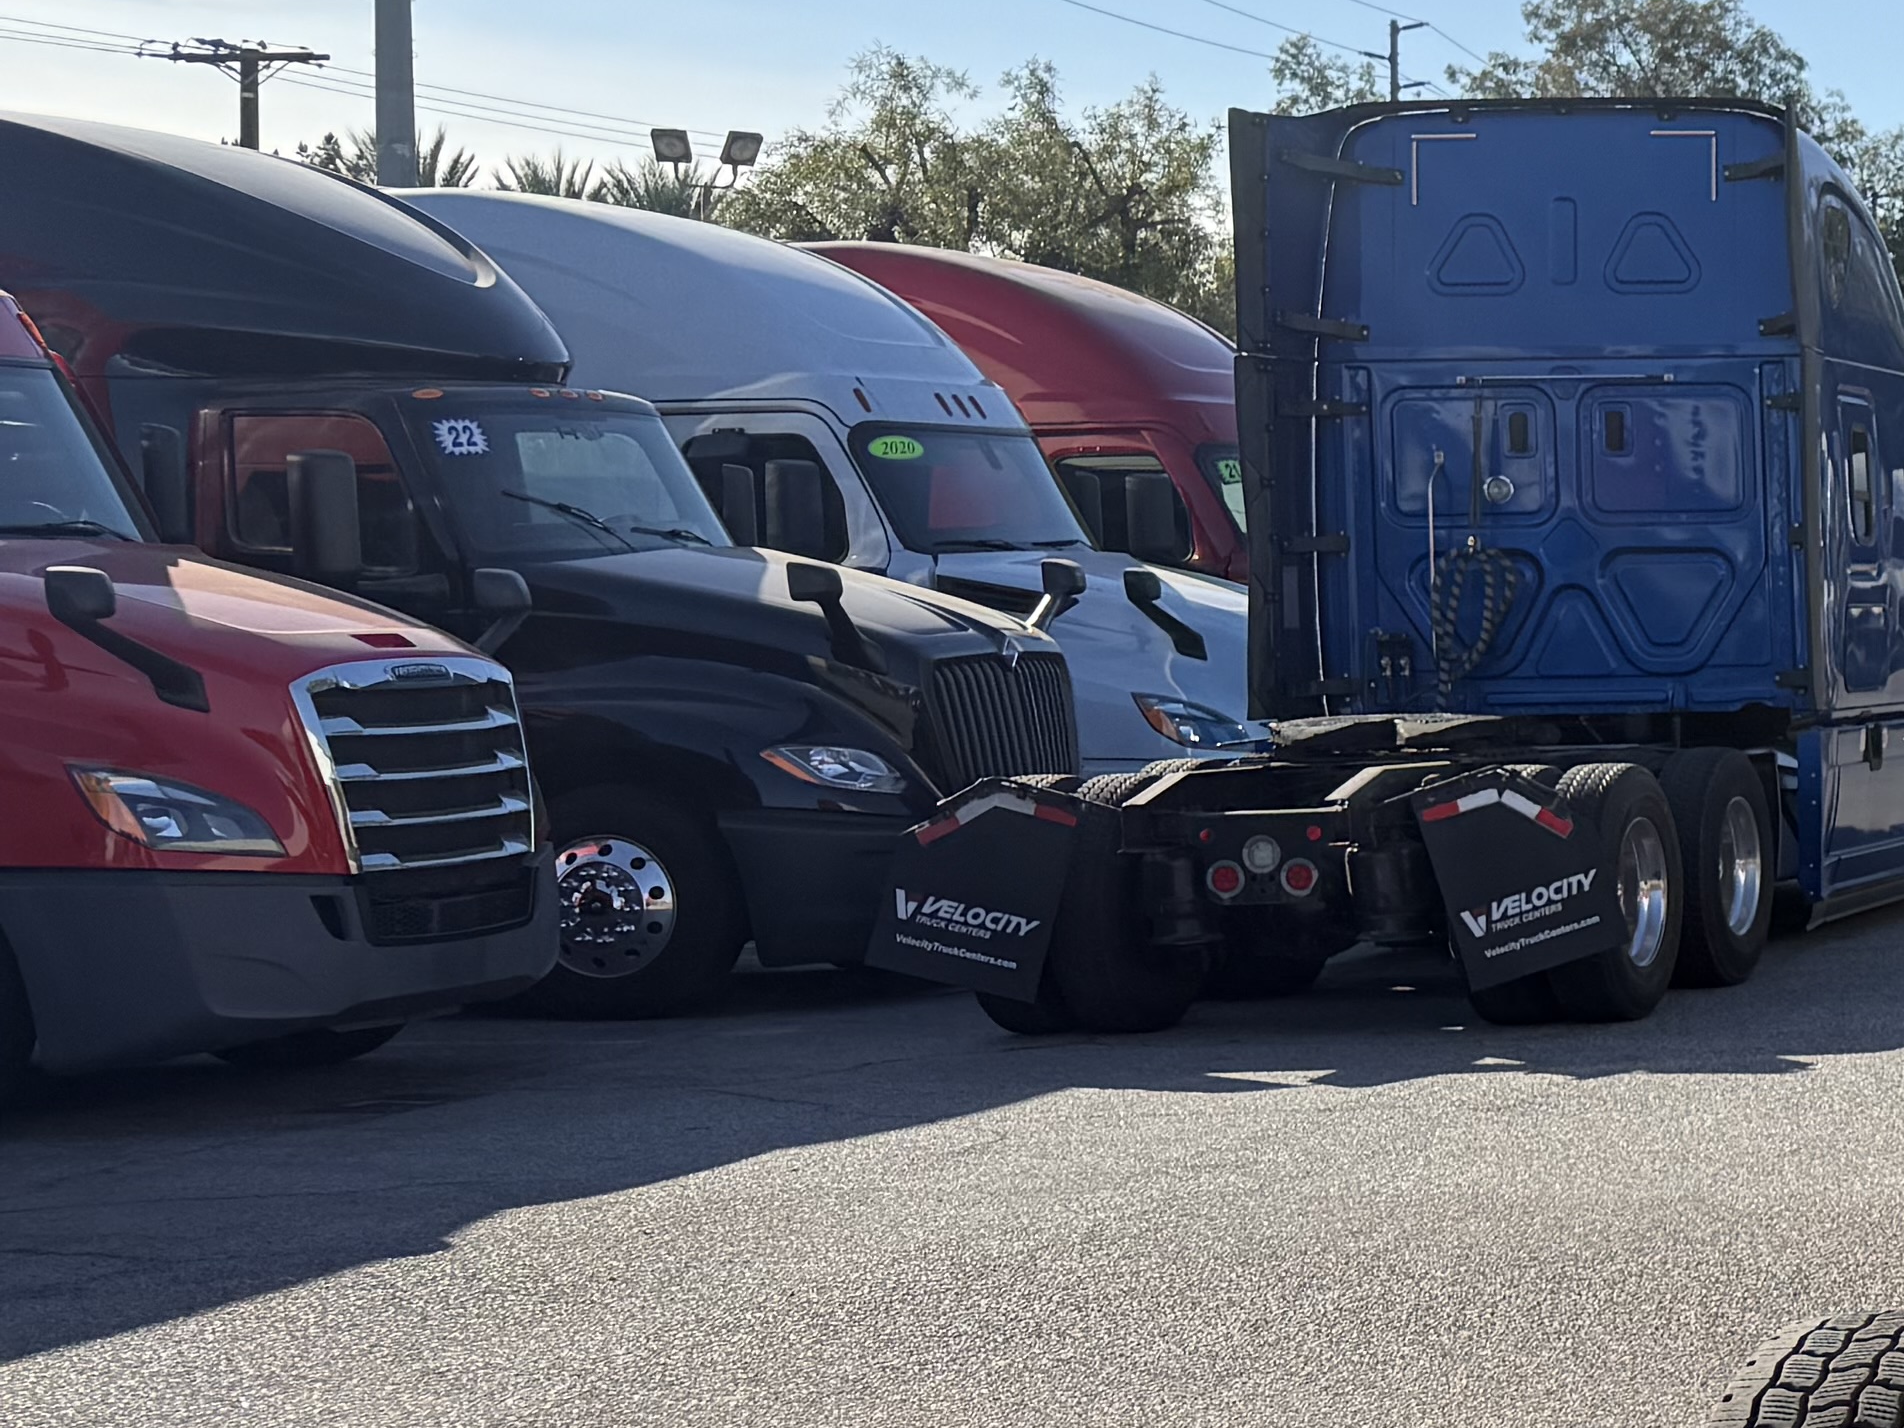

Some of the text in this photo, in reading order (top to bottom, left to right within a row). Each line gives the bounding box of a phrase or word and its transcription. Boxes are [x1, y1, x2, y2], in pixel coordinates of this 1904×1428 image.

[447, 425, 479, 448] 22
[880, 440, 916, 456] 2020
[1490, 868, 1597, 922] VELOCITY
[915, 913, 992, 940] TRUCK CENTERS
[920, 895, 1041, 937] VELOCITY
[1490, 901, 1564, 934] TRUCK CENTERS
[895, 932, 1018, 970] VelocityTruckCenters.com
[1484, 914, 1601, 959] VelocityTruckCenters.com
